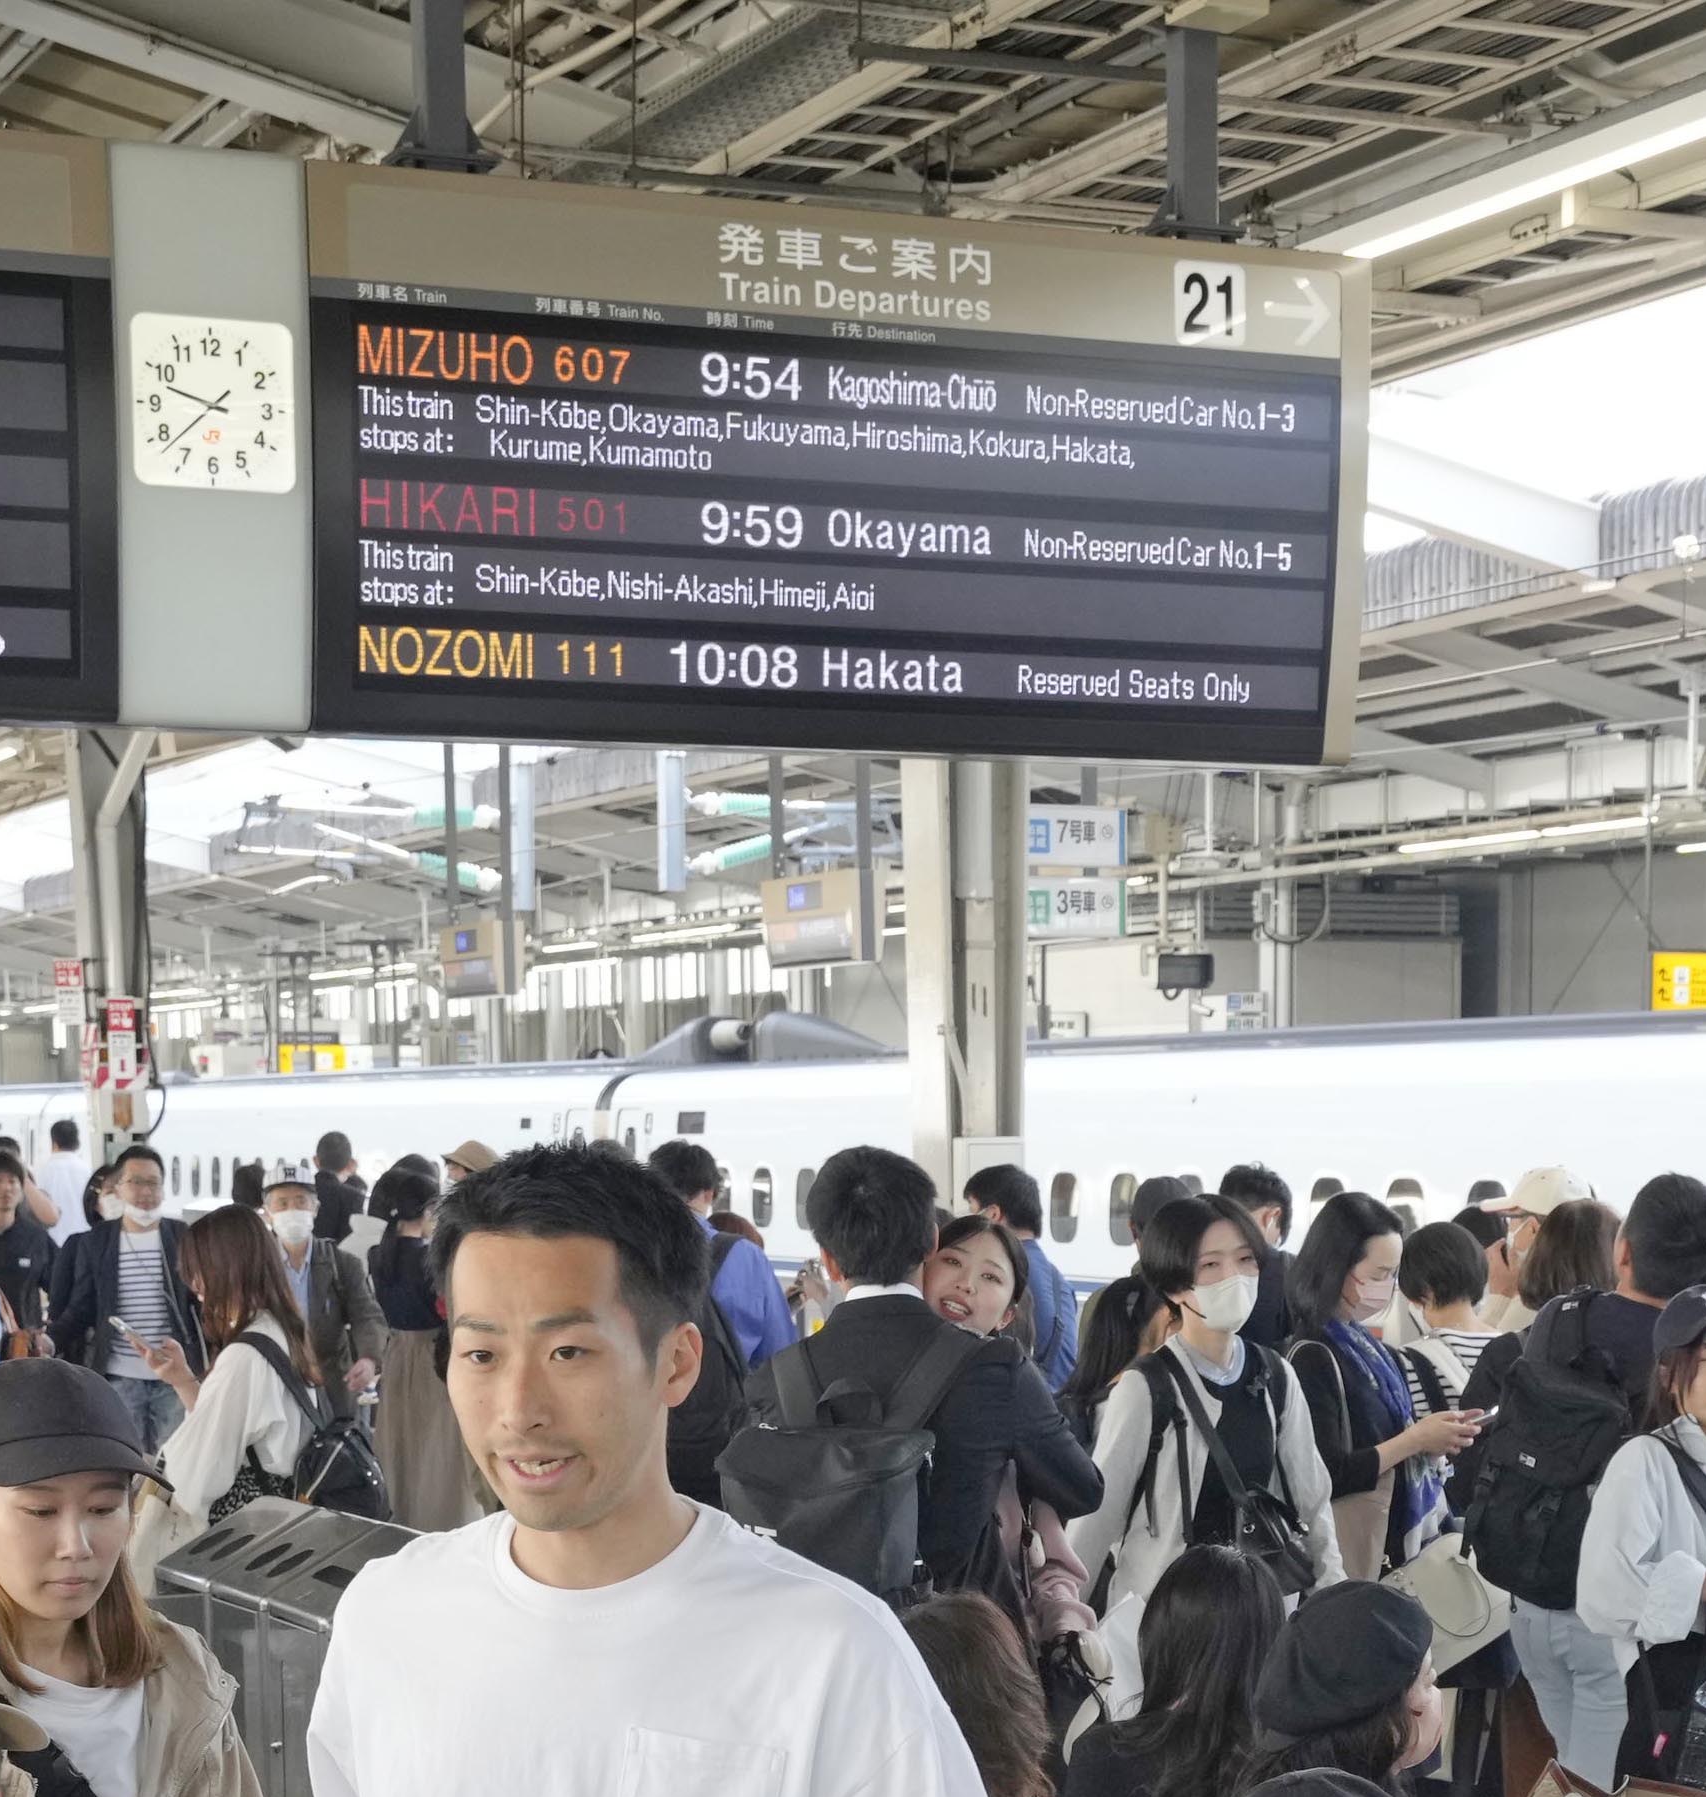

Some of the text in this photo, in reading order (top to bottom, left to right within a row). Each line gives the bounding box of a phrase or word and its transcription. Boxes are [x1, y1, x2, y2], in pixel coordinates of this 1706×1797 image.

[718, 222, 993, 286] 発車ご案内
[357, 283, 448, 305] 列車名 Train
[718, 273, 992, 323] Train Departures
[1181, 272, 1234, 338] 21
[535, 297, 665, 323] 列車番号 Train No.
[706, 311, 775, 332] 時刻 Time
[831, 321, 937, 345] 行先 Destination
[173, 345, 191, 363] 11
[200, 338, 221, 357] 12
[235, 349, 242, 367] 1
[155, 364, 175, 383] 10
[254, 371, 266, 390] 2
[357, 323, 535, 386] MIZUHO
[554, 348, 631, 385] 607
[699, 351, 803, 402] 9:54
[1025, 384, 1177, 426] Non-Reserved
[1178, 395, 1219, 427] Car
[149, 394, 161, 413] 9
[261, 403, 273, 421] 3
[357, 385, 454, 421] This train
[158, 423, 170, 442] 8
[254, 430, 266, 449] 4
[359, 426, 455, 455] stops at:
[180, 448, 191, 465] 7
[207, 456, 219, 475] 6
[236, 450, 246, 469] 5
[359, 478, 536, 537] HIKARI
[556, 499, 627, 534] 501
[699, 500, 803, 549] 9:59
[827, 508, 992, 558] Okayama
[1023, 527, 1175, 565] Non-Reserved
[1176, 537, 1216, 568] Car
[359, 540, 454, 573] This train
[360, 579, 455, 608] stops at:
[358, 624, 1251, 704] NOZOMI 111 10:08 Hakata Reserved Seats Only
[1056, 819, 1096, 845] 7号車
[1056, 889, 1096, 915] 3号車
